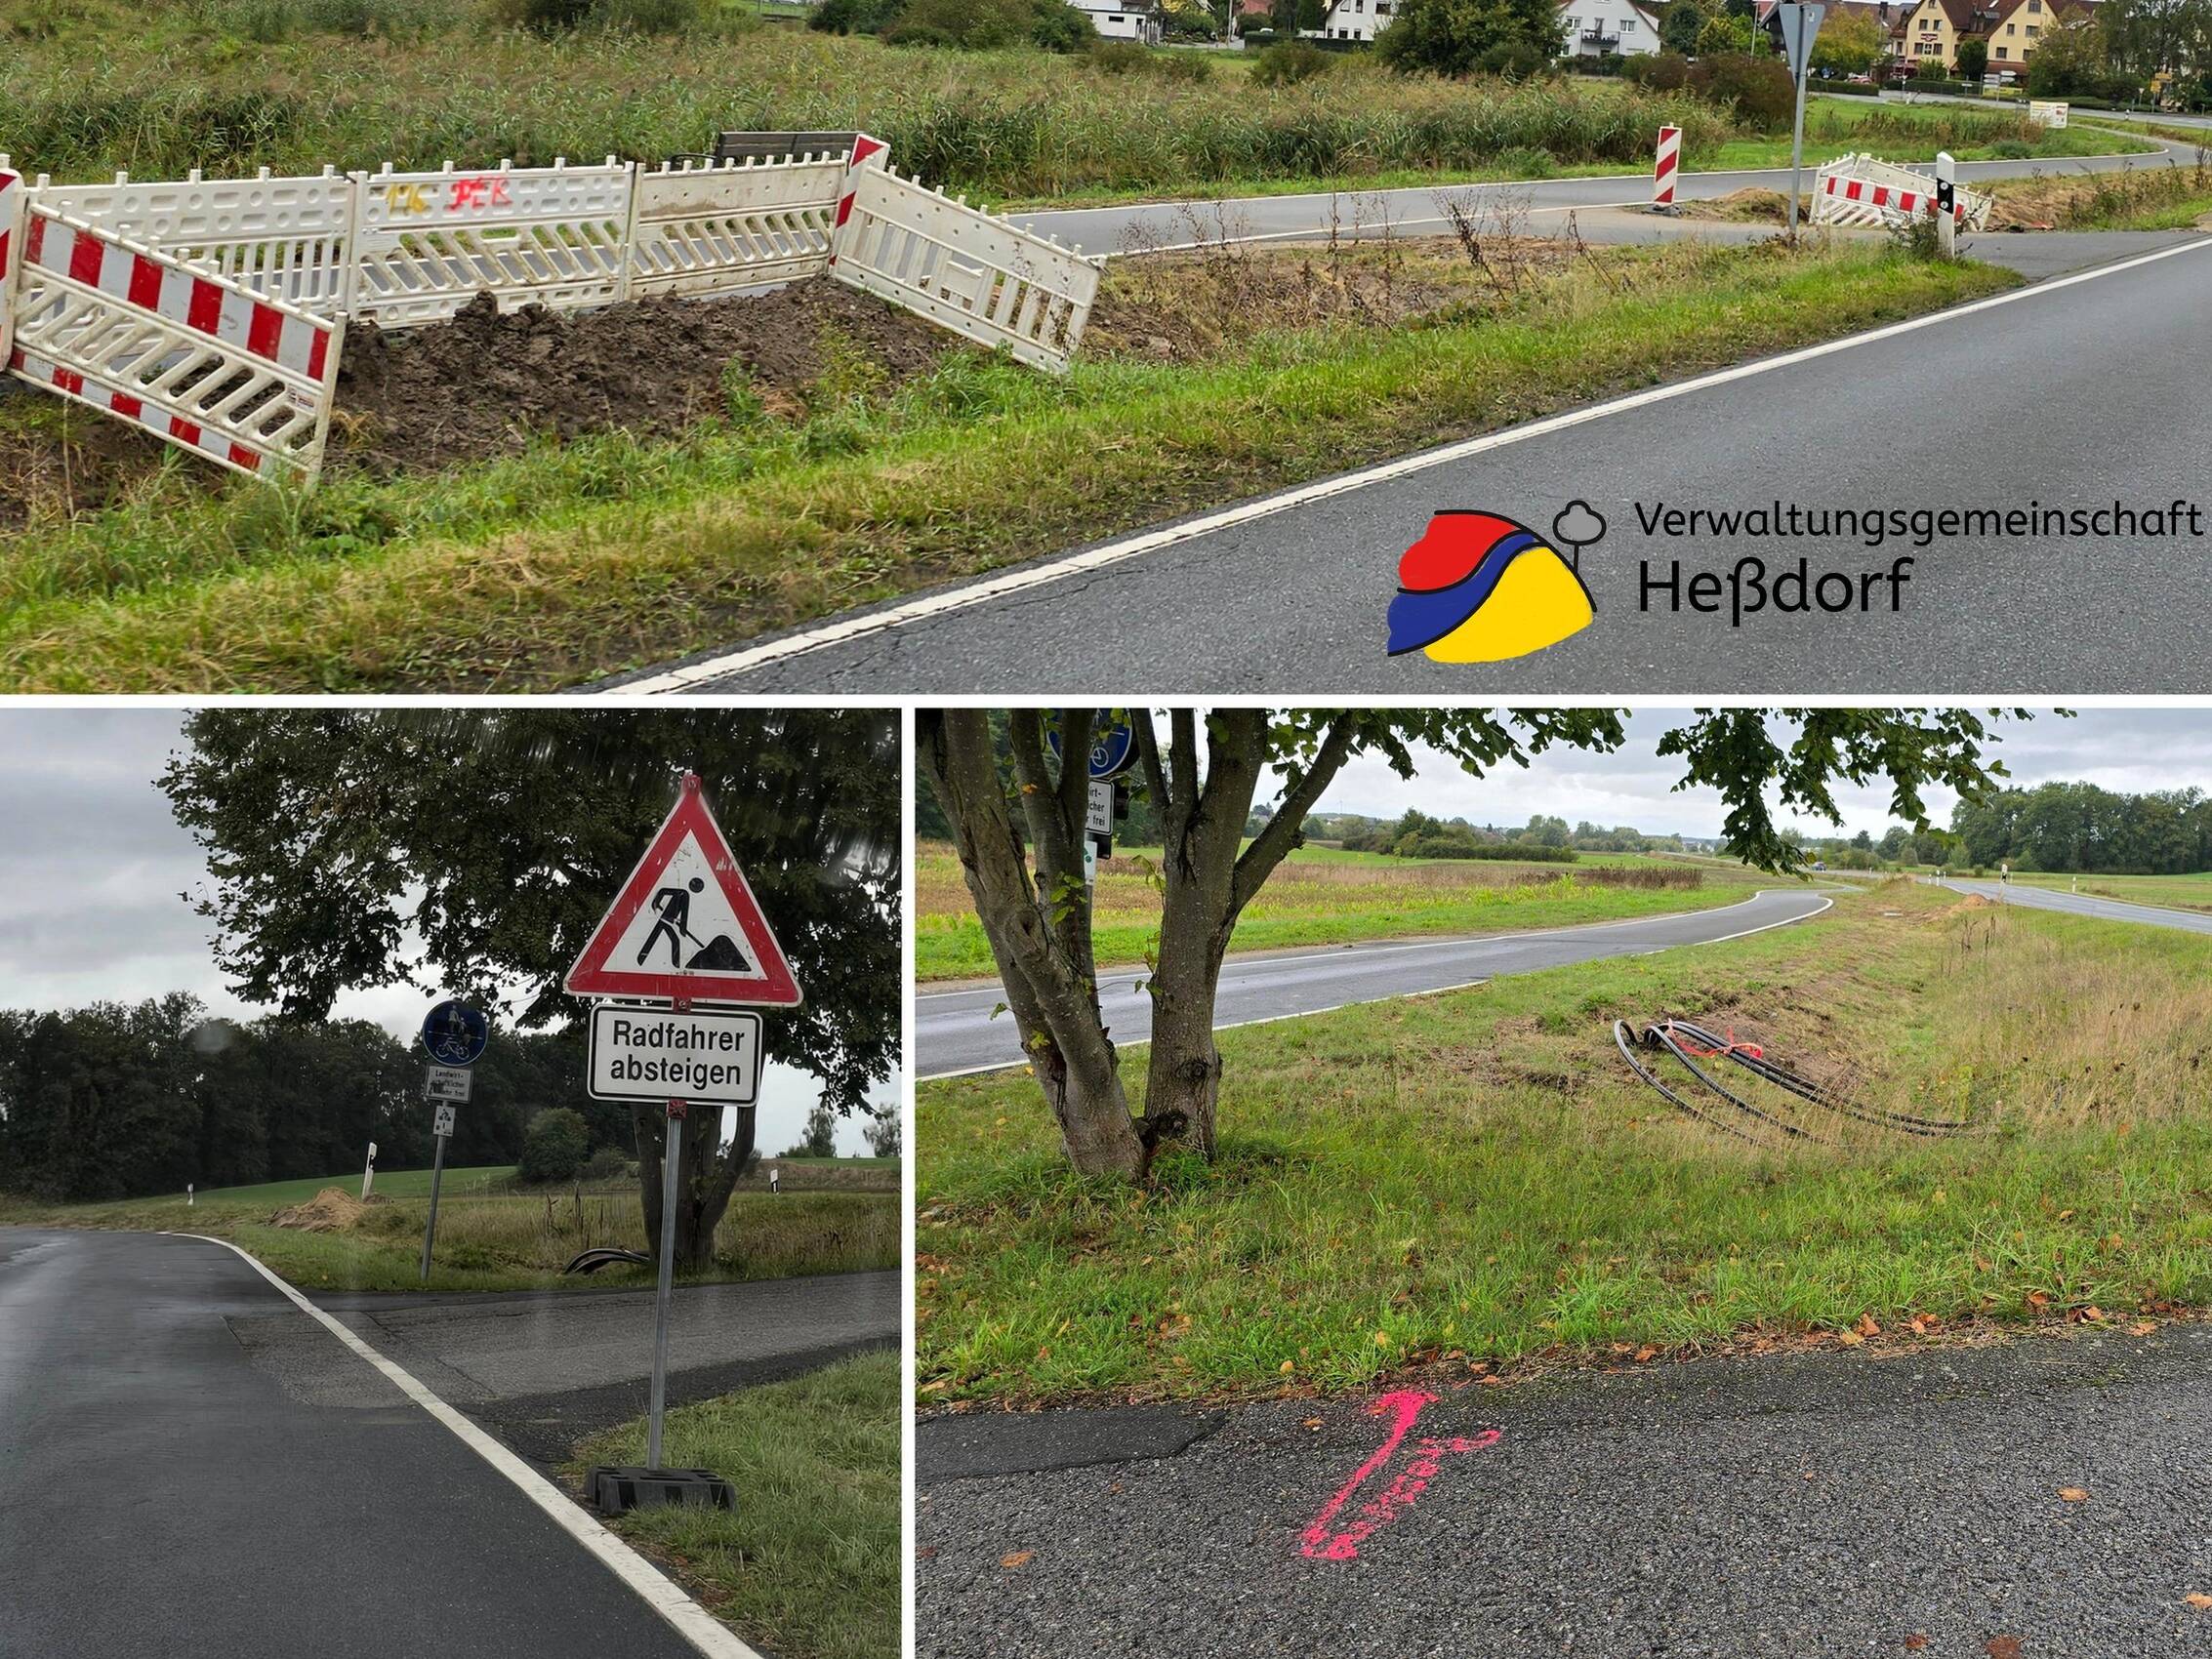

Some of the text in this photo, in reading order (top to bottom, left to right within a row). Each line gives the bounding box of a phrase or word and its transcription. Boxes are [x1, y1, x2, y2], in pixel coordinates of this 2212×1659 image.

[1092, 814, 1105, 827] frei
[613, 1020, 745, 1051] Radfahrer
[610, 1054, 741, 1091] absteigen
